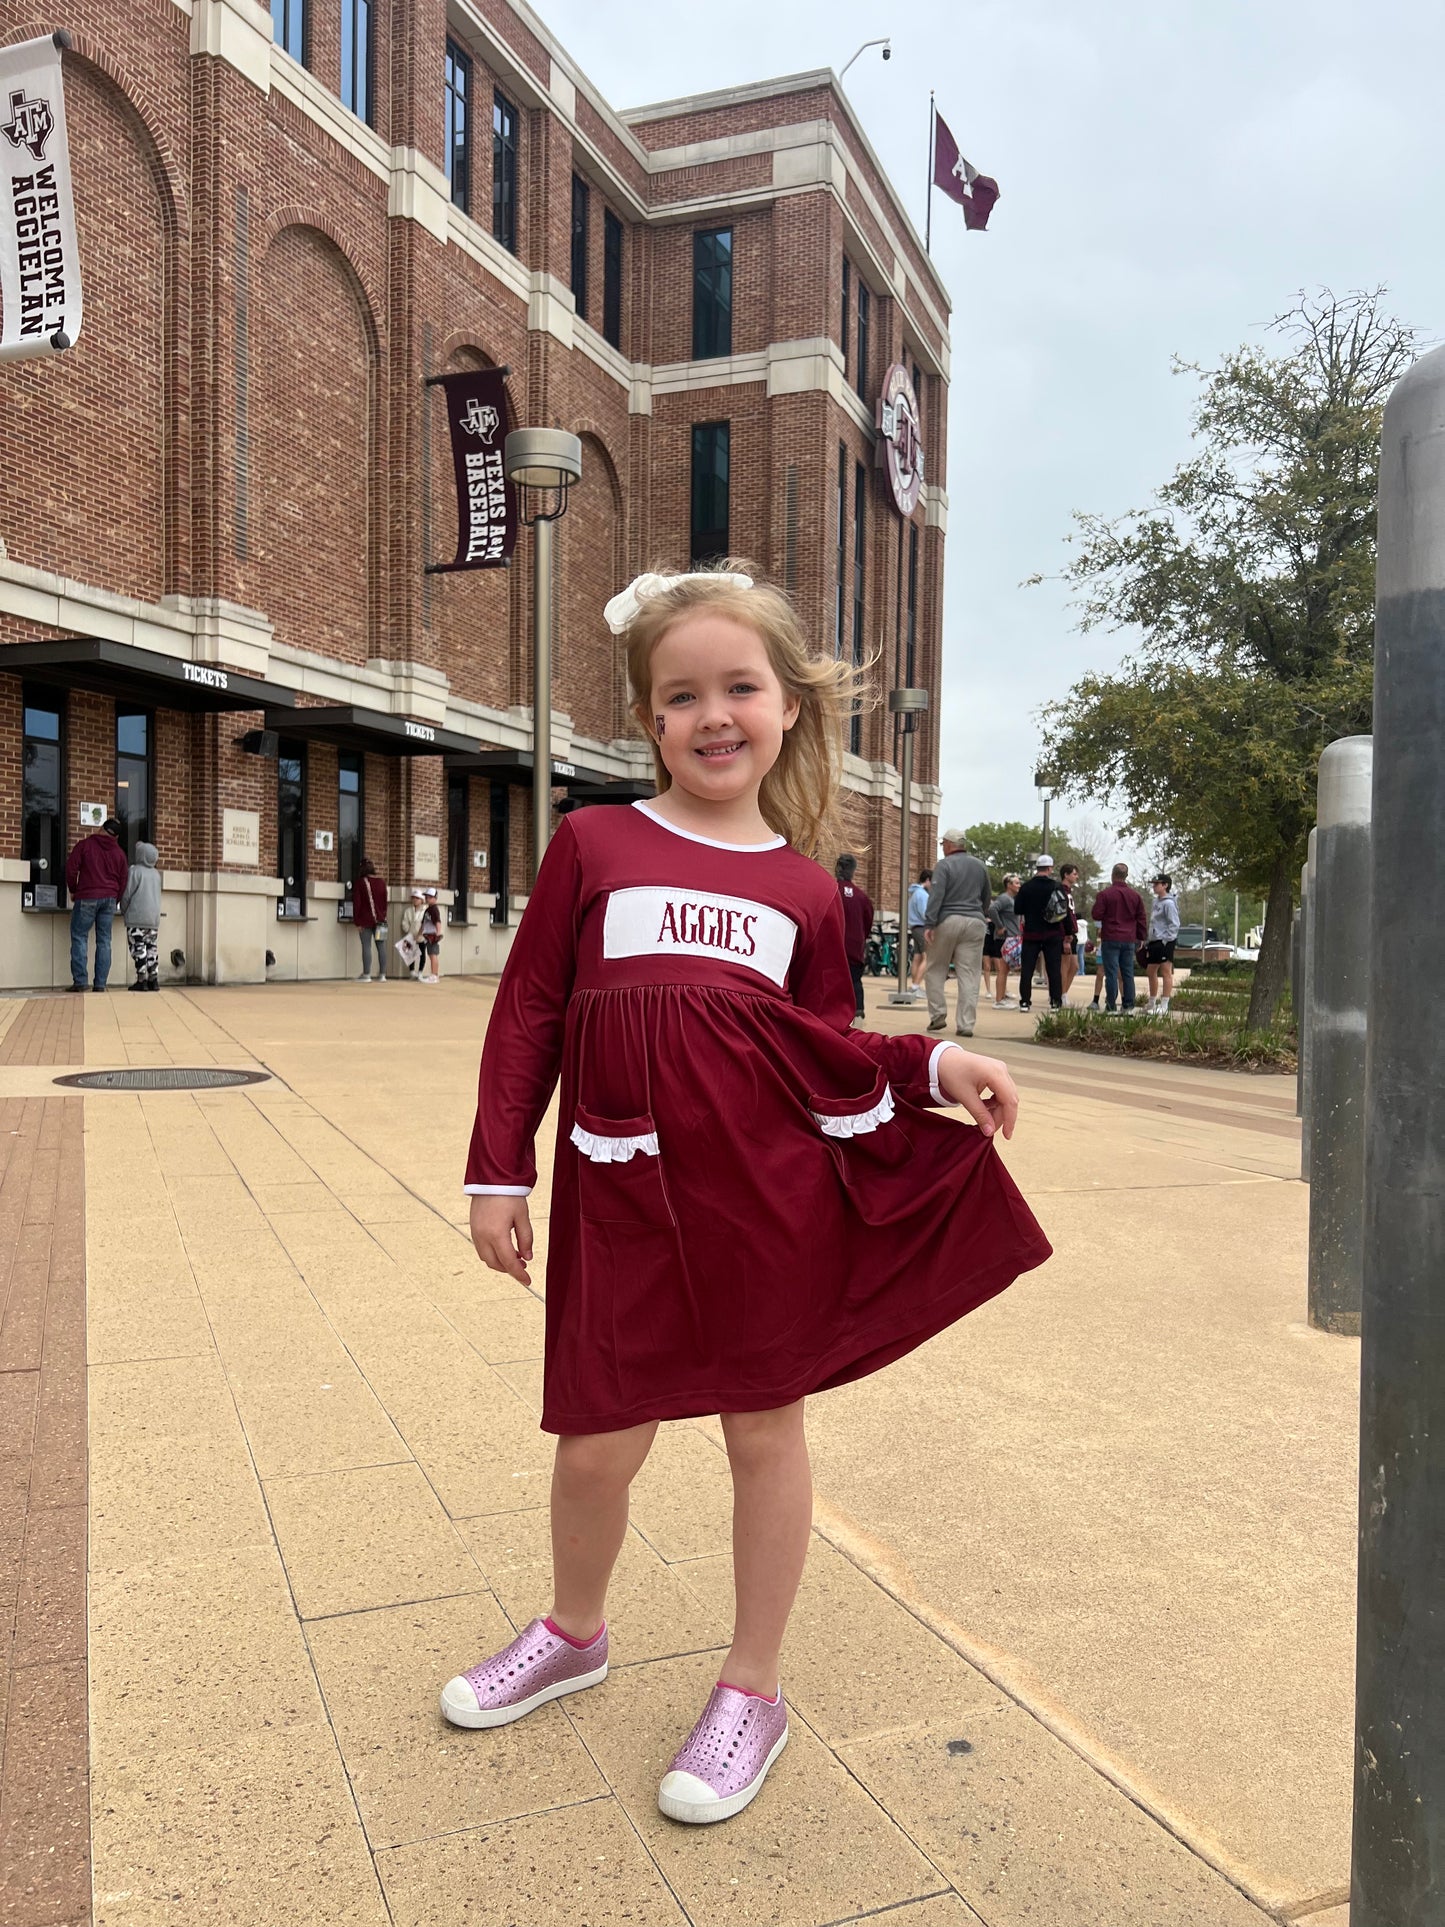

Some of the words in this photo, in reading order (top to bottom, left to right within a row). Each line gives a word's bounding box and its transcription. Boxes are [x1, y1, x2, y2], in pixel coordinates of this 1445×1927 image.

[12, 175, 43, 340] AGGIELAN
[36, 164, 65, 307] WELCOME
[45, 316, 65, 333] T
[465, 452, 489, 562] BASEBALL
[485, 450, 507, 519] TEXAS
[484, 525, 507, 560] A&M
[182, 662, 228, 689] TICKETS
[405, 721, 435, 741] TICKETS
[657, 901, 758, 956] AGGIES
